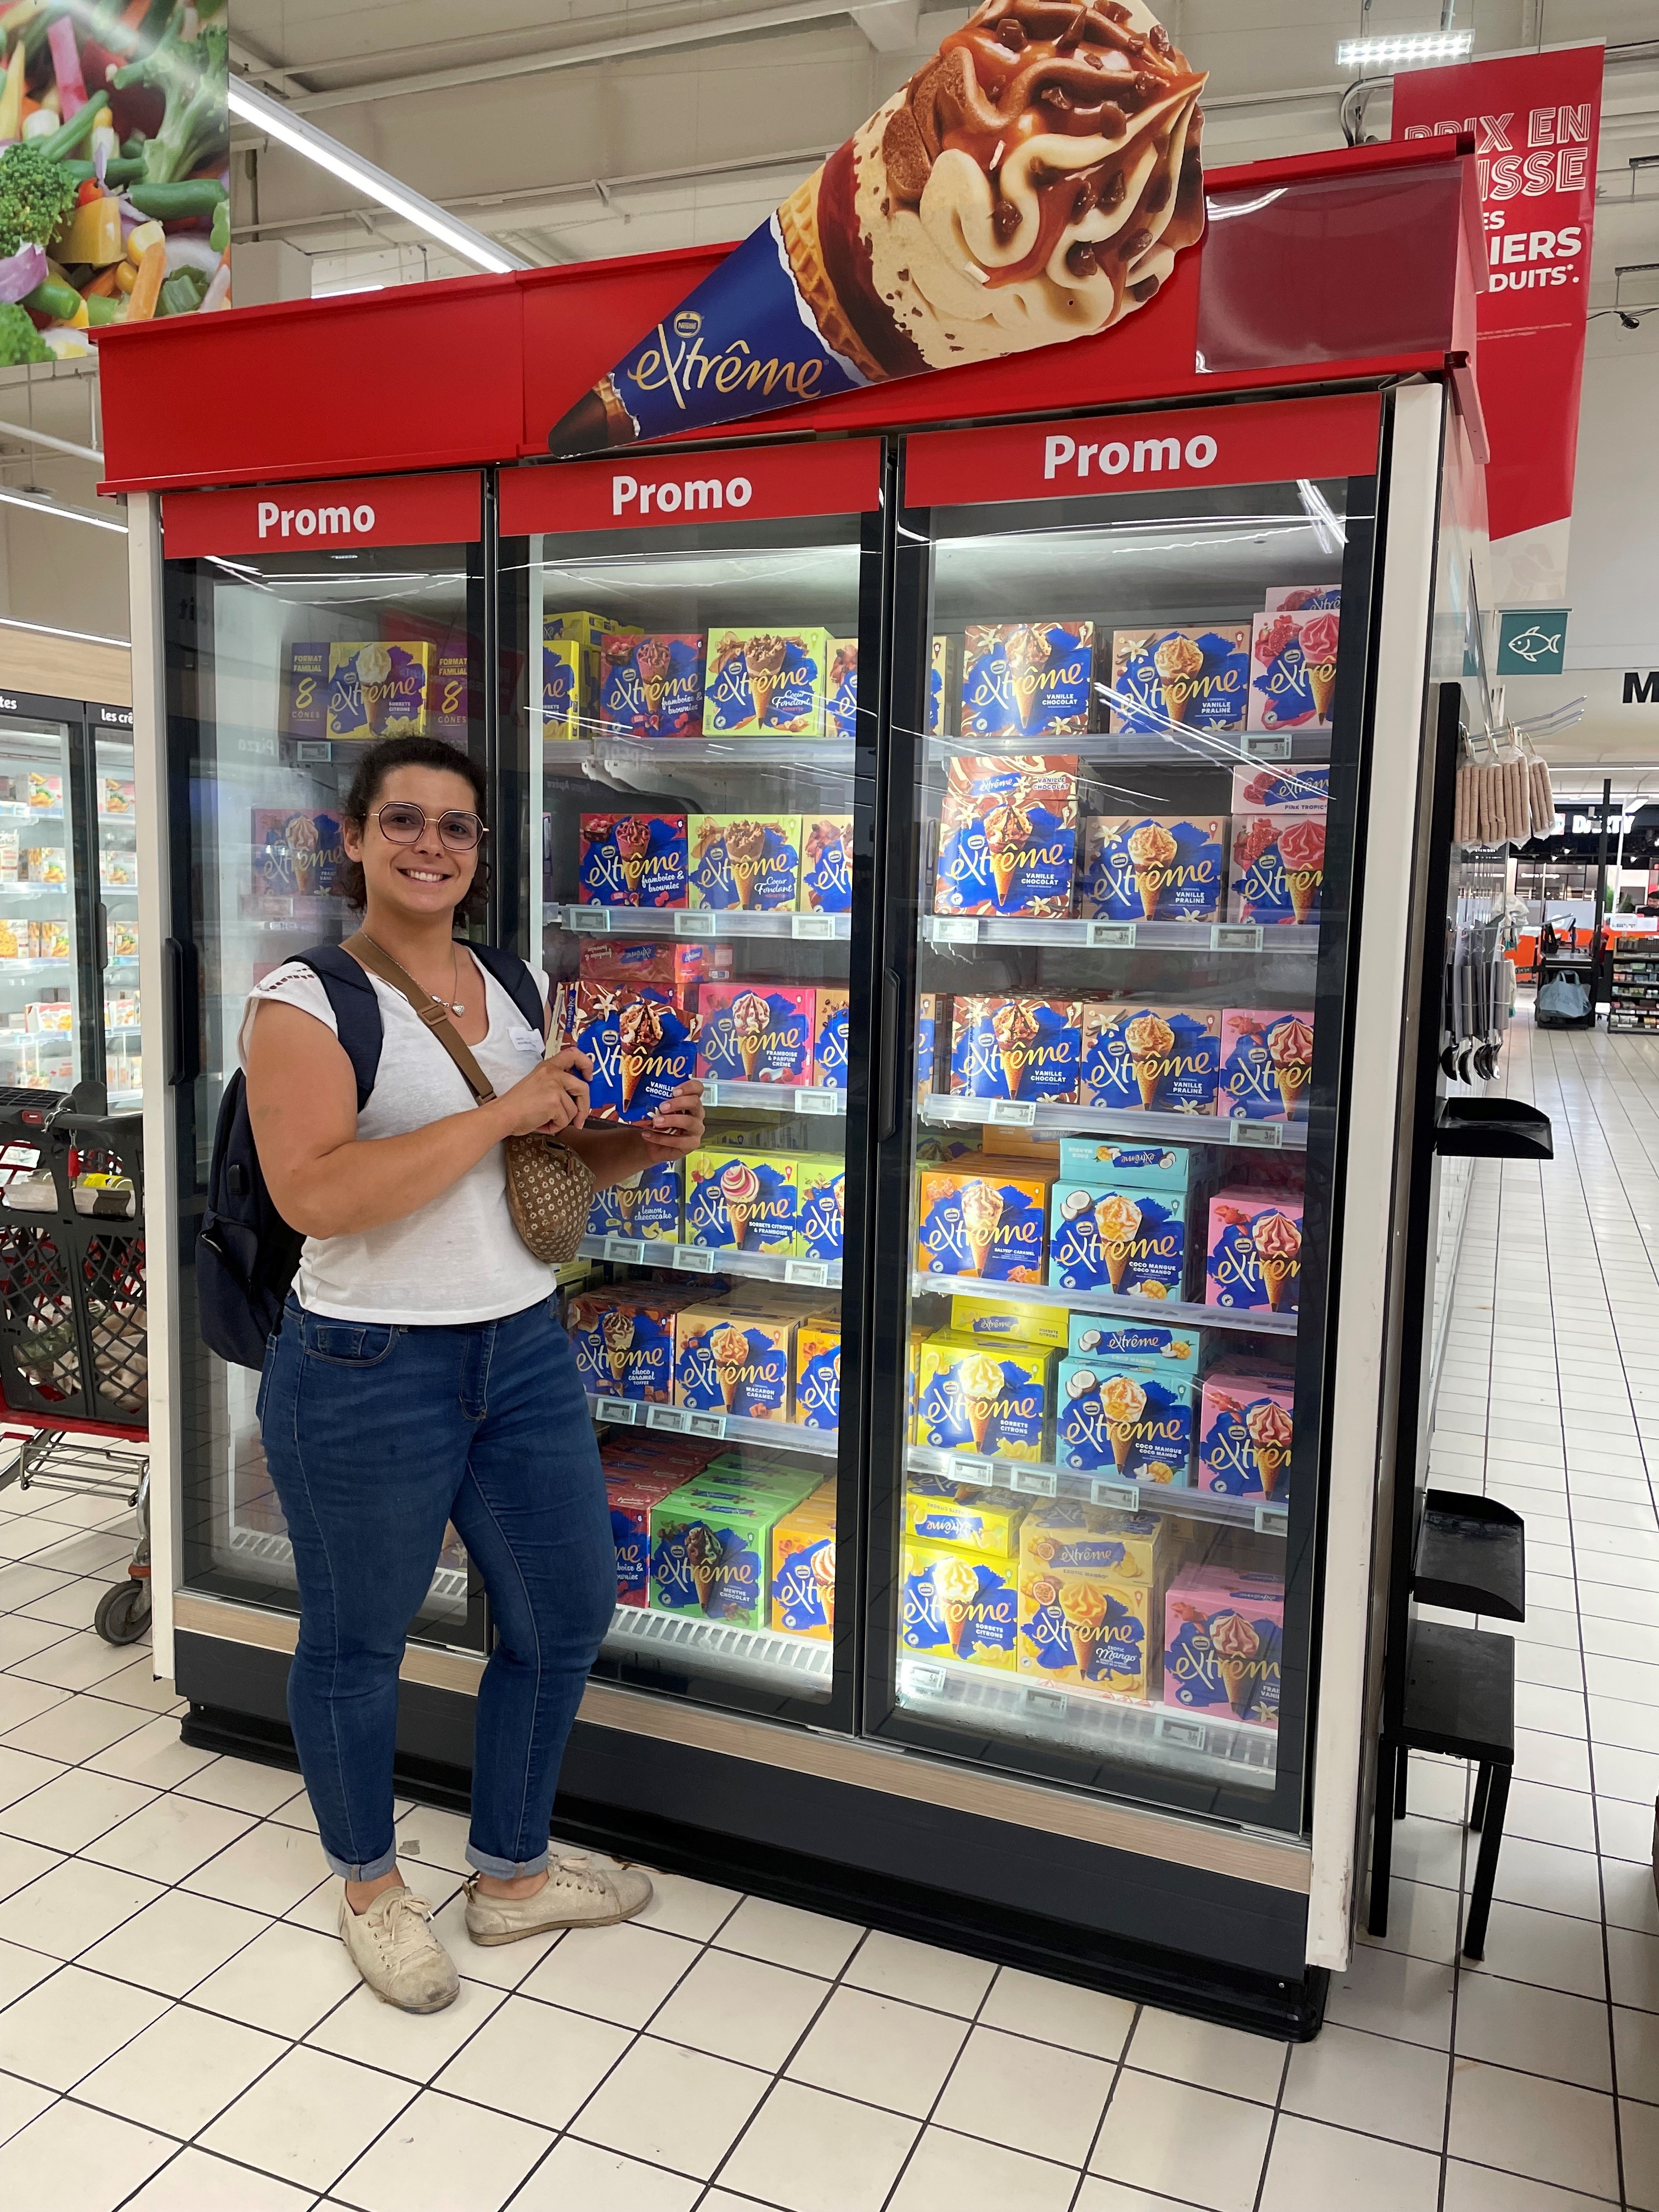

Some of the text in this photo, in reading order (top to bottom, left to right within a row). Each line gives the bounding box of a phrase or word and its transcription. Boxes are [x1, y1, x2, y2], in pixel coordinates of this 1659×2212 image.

[1527, 104, 1591, 148] EN
[1477, 147, 1588, 201] ISSE
[1489, 227, 1582, 265] IERS
[1489, 264, 1579, 292] DUITS.
[628, 323, 822, 409] extrême
[1044, 435, 1217, 479] Promo
[613, 476, 752, 515] Promo
[258, 501, 375, 538] Promo
[1266, 656, 1337, 697] extrê
[295, 677, 317, 709] 8
[1623, 672, 1659, 703] M
[0, 696, 17, 710] tes
[442, 680, 462, 714] 8
[661, 692, 702, 710] framboise &
[771, 695, 810, 708] Fondant
[101, 709, 133, 724] les crê
[1277, 777, 1328, 798] extrêm
[642, 871, 684, 889] framboise &
[766, 877, 787, 885] Coeur
[648, 882, 679, 893] brownies
[754, 883, 792, 895] Fondant
[646, 1086, 673, 1097] CHOCOLA
[635, 1210, 672, 1220] cheesecake
[642, 1205, 663, 1214] lemon
[629, 1371, 655, 1380] caramel
[632, 1367, 650, 1375] choco
[746, 1387, 775, 1395] MACARON
[1000, 1420, 1028, 1428] SORBETS
[1154, 1446, 1182, 1454] MANGUE
[617, 1562, 635, 1572] boise
[617, 1572, 638, 1580] ownies
[720, 1592, 750, 1601] CHOCOLAT
[723, 1587, 746, 1596] MENTHE
[976, 1623, 1003, 1633] SORBETS
[976, 1629, 1003, 1639] CITRONS
[1169, 1642, 1280, 1690] extrêm
